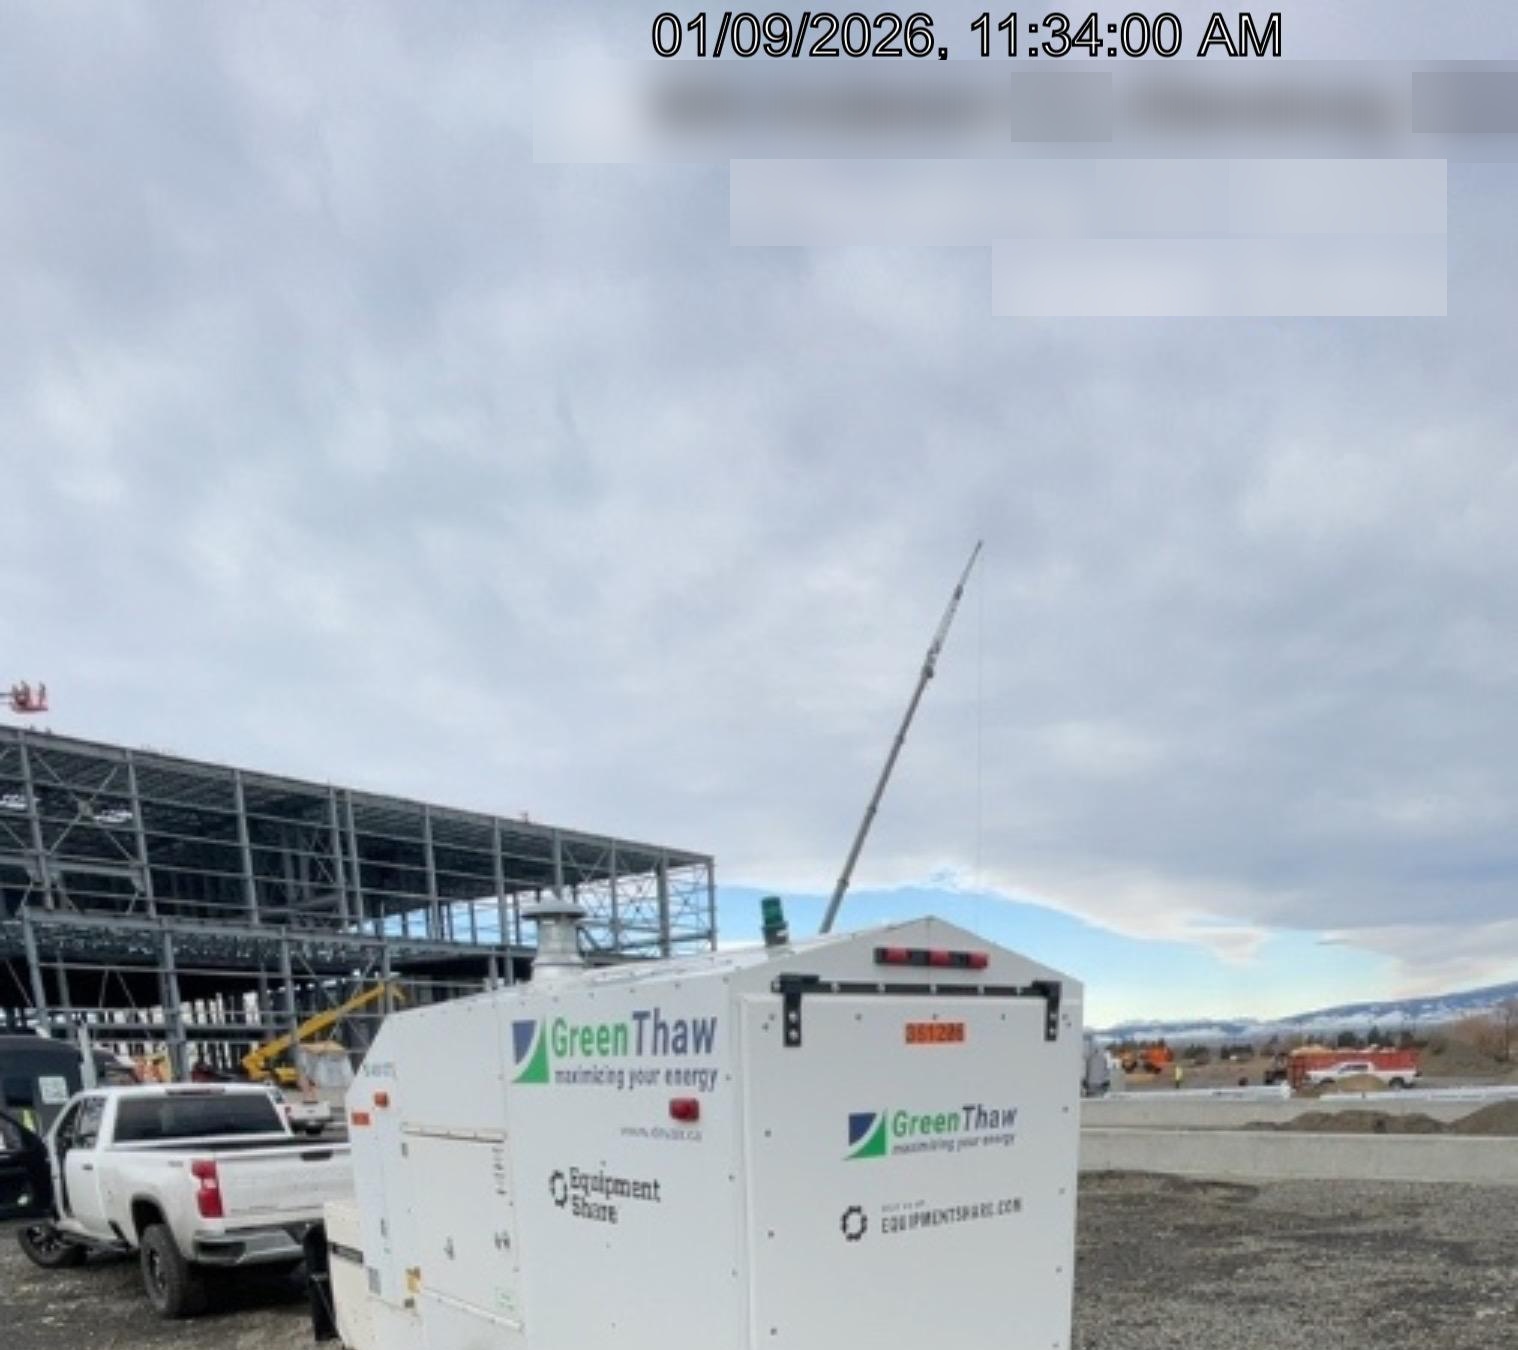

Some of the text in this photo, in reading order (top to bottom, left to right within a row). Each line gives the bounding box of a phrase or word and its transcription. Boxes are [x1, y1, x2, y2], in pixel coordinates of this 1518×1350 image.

[551, 1007, 718, 1058] GreenThaw
[555, 1064, 719, 1093] maximizing your energy
[892, 1104, 1018, 1138] GreenThaw
[569, 1166, 661, 1203] Equipment
[572, 1196, 618, 1224] Share
